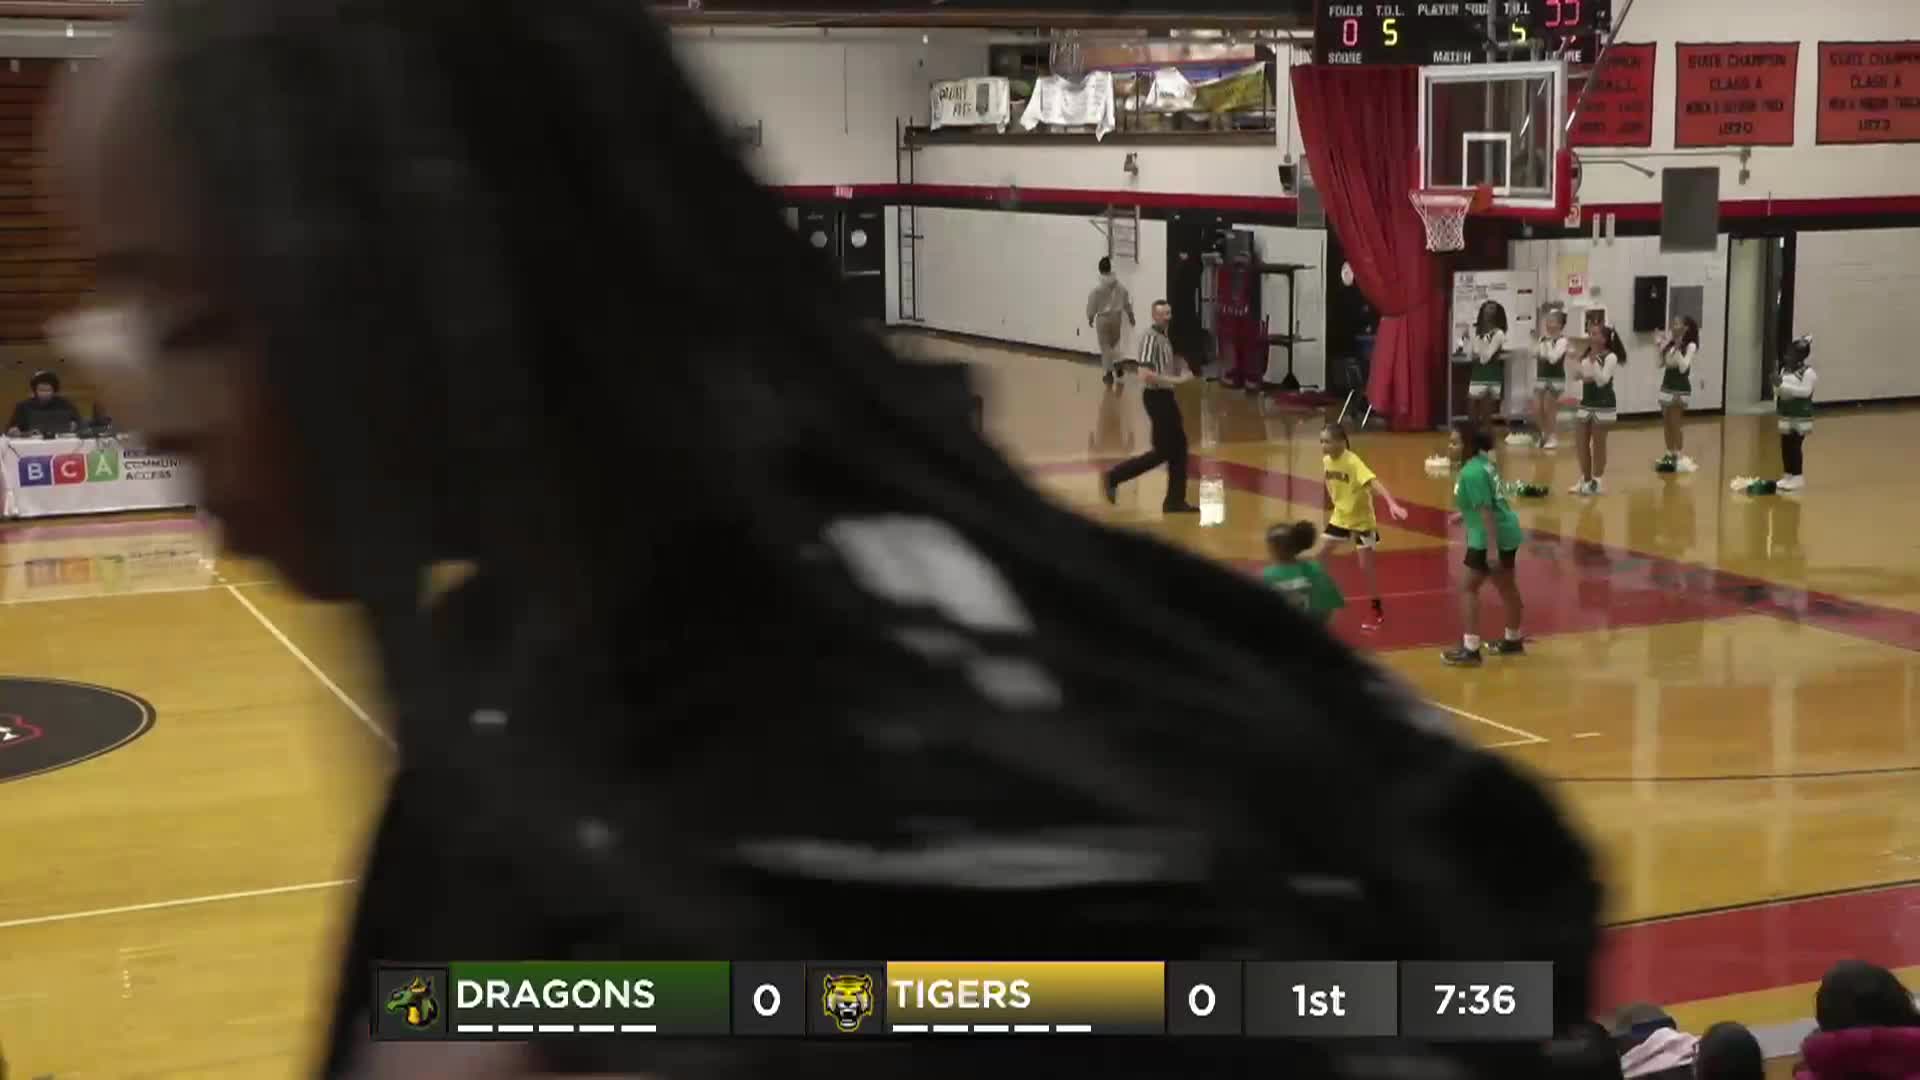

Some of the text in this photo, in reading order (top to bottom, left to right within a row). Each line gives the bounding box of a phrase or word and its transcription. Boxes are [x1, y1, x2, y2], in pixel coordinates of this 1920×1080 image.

[1329, 5, 1363, 16] FOULS
[1417, 4, 1459, 16] PLAYER
[1343, 18, 1358, 46] 0
[1382, 18, 1398, 46] 5
[1328, 52, 1362, 64] SCORE
[1433, 51, 1471, 63] MATCH
[1688, 54, 1786, 68] STATE CHAMPION
[1830, 53, 1863, 66] STATE
[1710, 77, 1763, 90] CLASS A
[1850, 73, 1887, 88] CLASS
[126, 470, 172, 480] ACCESS
